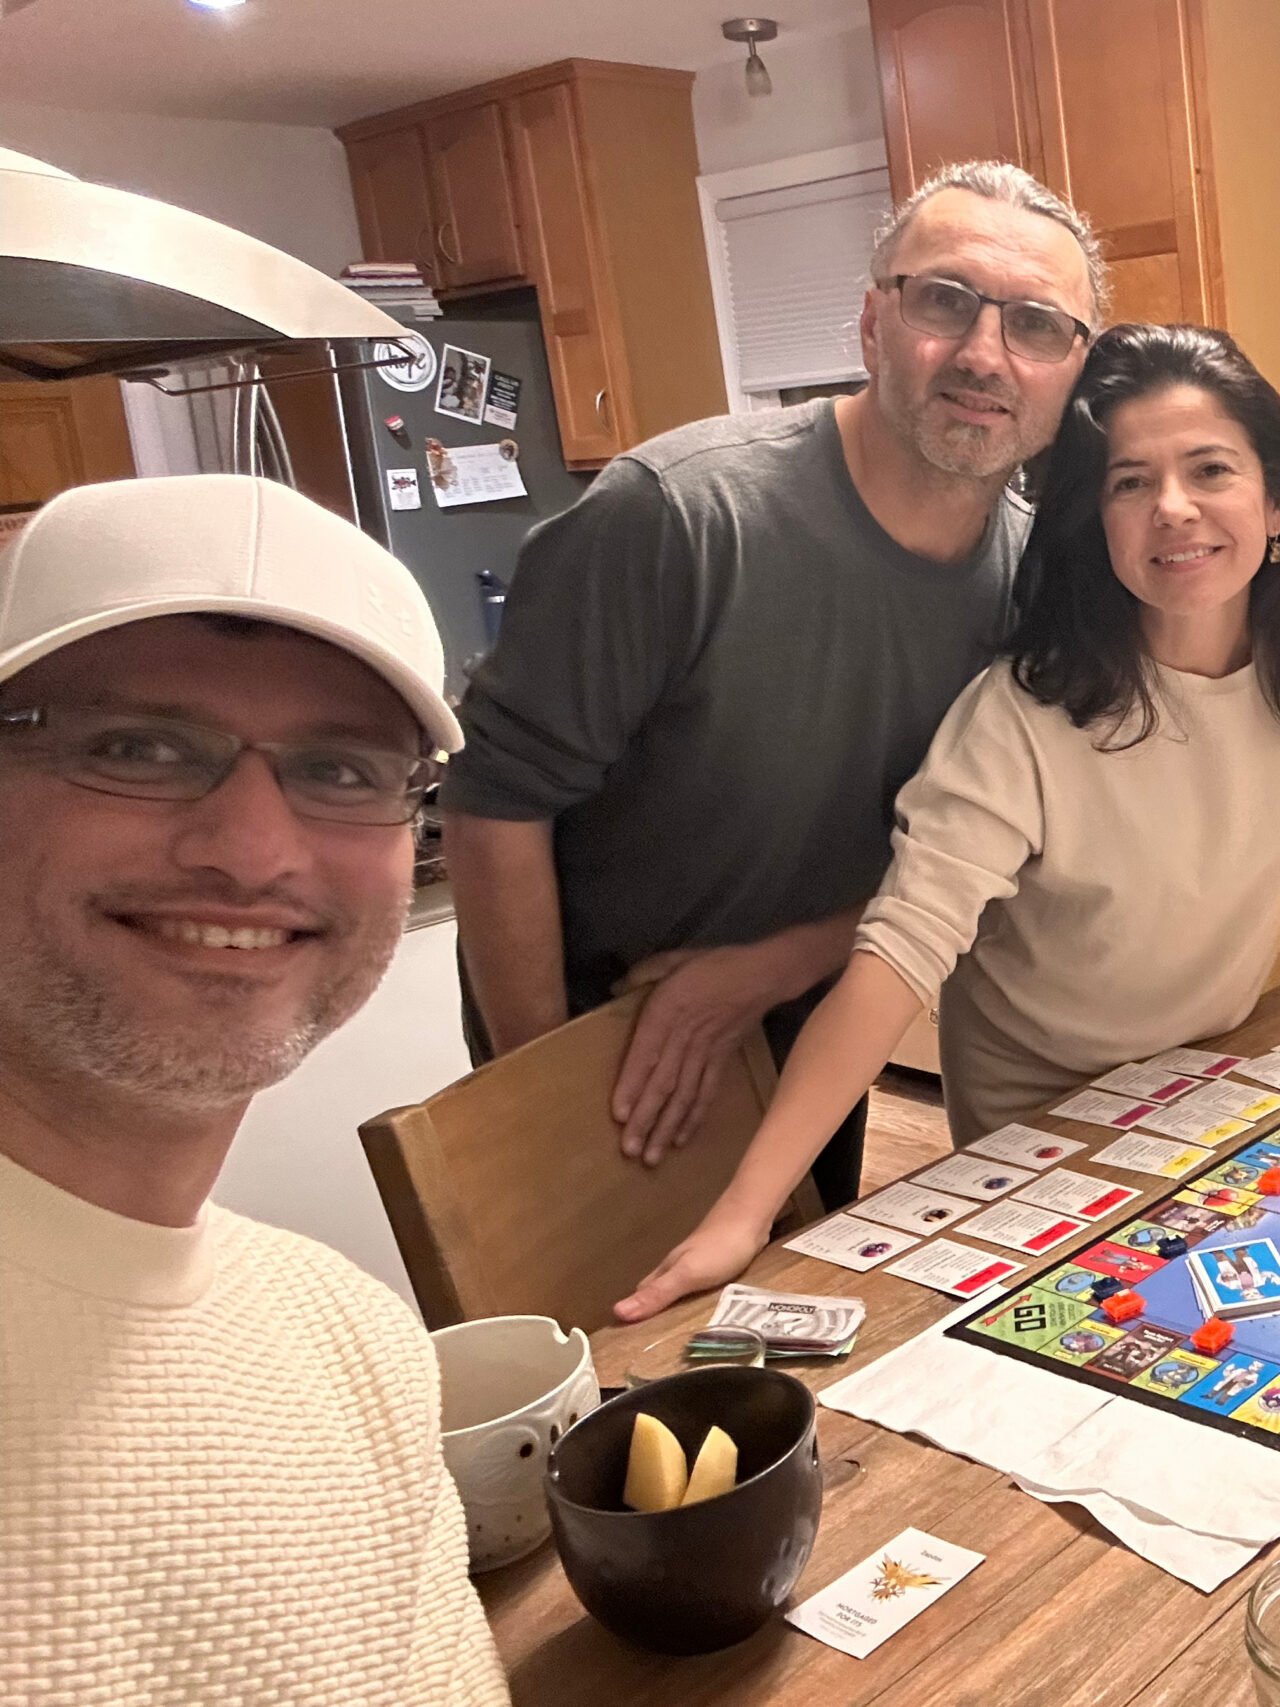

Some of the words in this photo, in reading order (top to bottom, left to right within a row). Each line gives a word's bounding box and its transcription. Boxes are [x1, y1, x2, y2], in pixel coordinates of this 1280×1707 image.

[770, 1304, 815, 1314] MONOPOLY
[1014, 1304, 1047, 1332] GO
[837, 1603, 878, 1625] MORTGAGED
